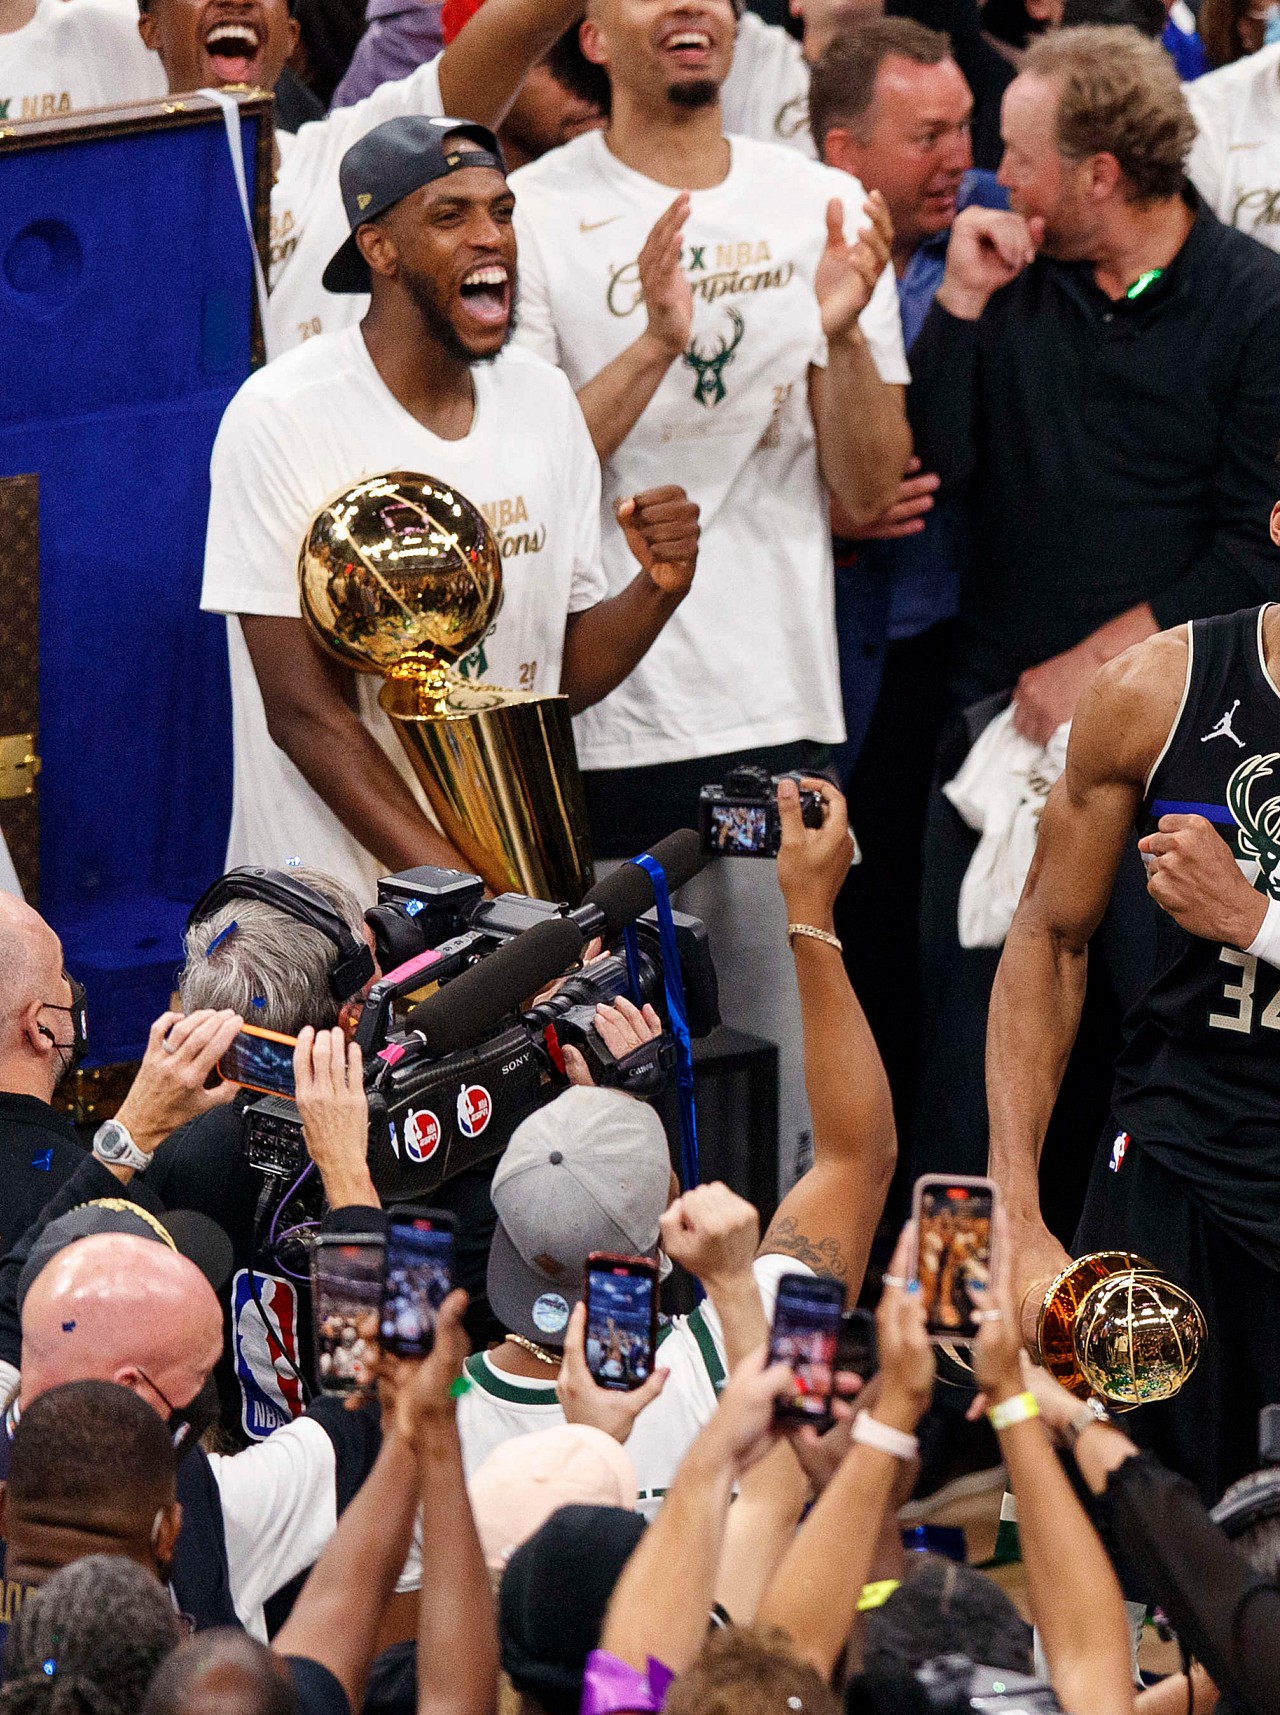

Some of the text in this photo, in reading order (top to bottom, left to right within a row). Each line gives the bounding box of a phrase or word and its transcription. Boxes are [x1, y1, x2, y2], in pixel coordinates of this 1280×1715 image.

[679, 240, 772, 270] X NBA
[481, 495, 528, 528] NBA
[501, 1052, 530, 1076] SONY
[628, 1061, 655, 1078] Canon
[253, 1400, 286, 1428] NBA
